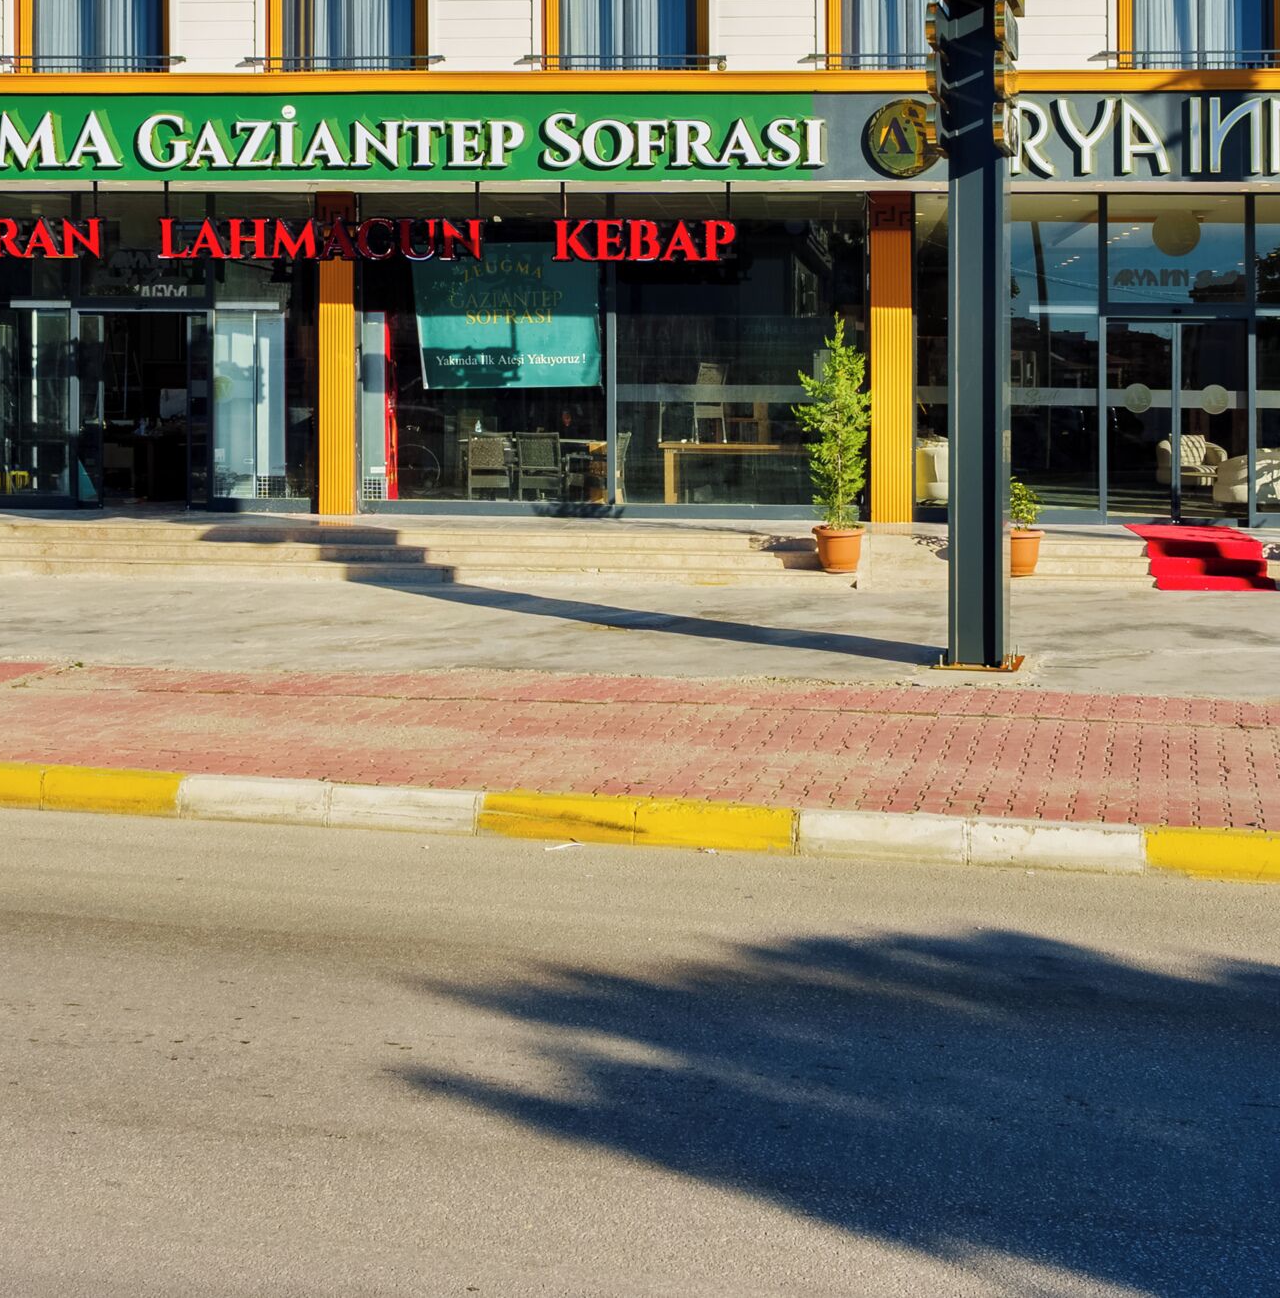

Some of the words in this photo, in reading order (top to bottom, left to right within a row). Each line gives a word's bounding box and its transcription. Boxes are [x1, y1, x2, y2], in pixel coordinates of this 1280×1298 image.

[137, 105, 526, 169] GAZİANTEP
[542, 112, 826, 168] SOFRASI
[157, 216, 486, 261] LAHMACUN
[552, 218, 737, 261] KEBAP
[463, 259, 543, 283] ZEUGMA
[465, 308, 553, 324] SOFRASI
[436, 355, 477, 366] Yakında
[480, 353, 495, 365] İlk
[498, 354, 524, 366] Ateşi
[527, 354, 580, 367] Yakıyoruz
